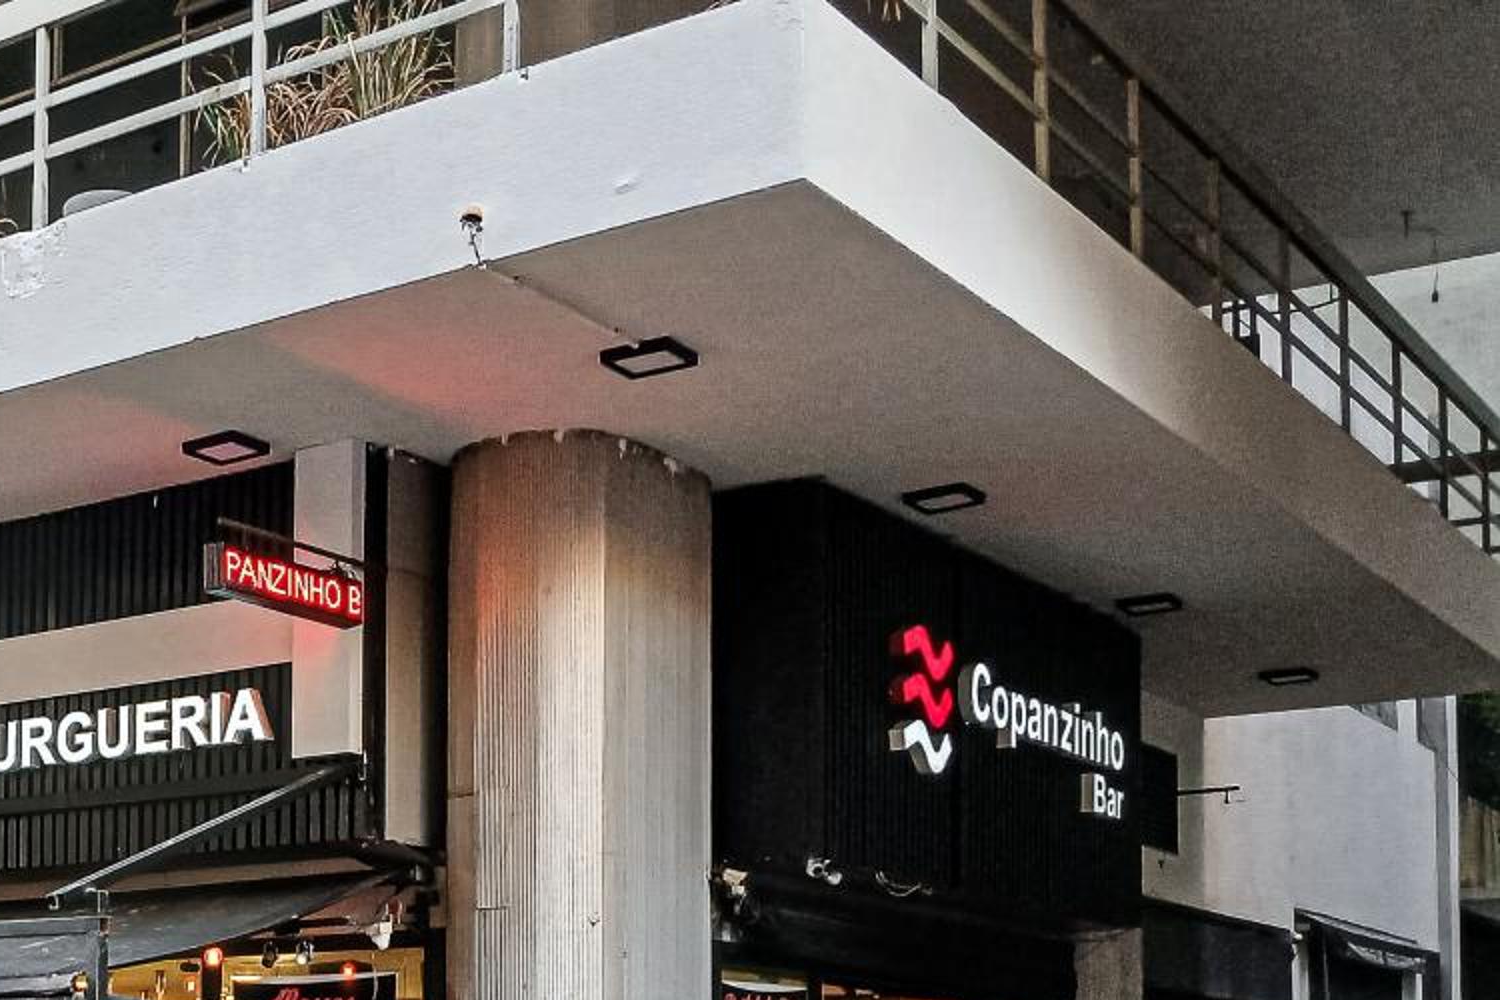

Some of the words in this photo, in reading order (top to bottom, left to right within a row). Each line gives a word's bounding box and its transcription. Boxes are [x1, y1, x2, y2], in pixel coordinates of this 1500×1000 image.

[226, 552, 342, 609] PANZINHO
[970, 662, 1125, 771] Copanzinho
[1092, 773, 1125, 818] Bar
